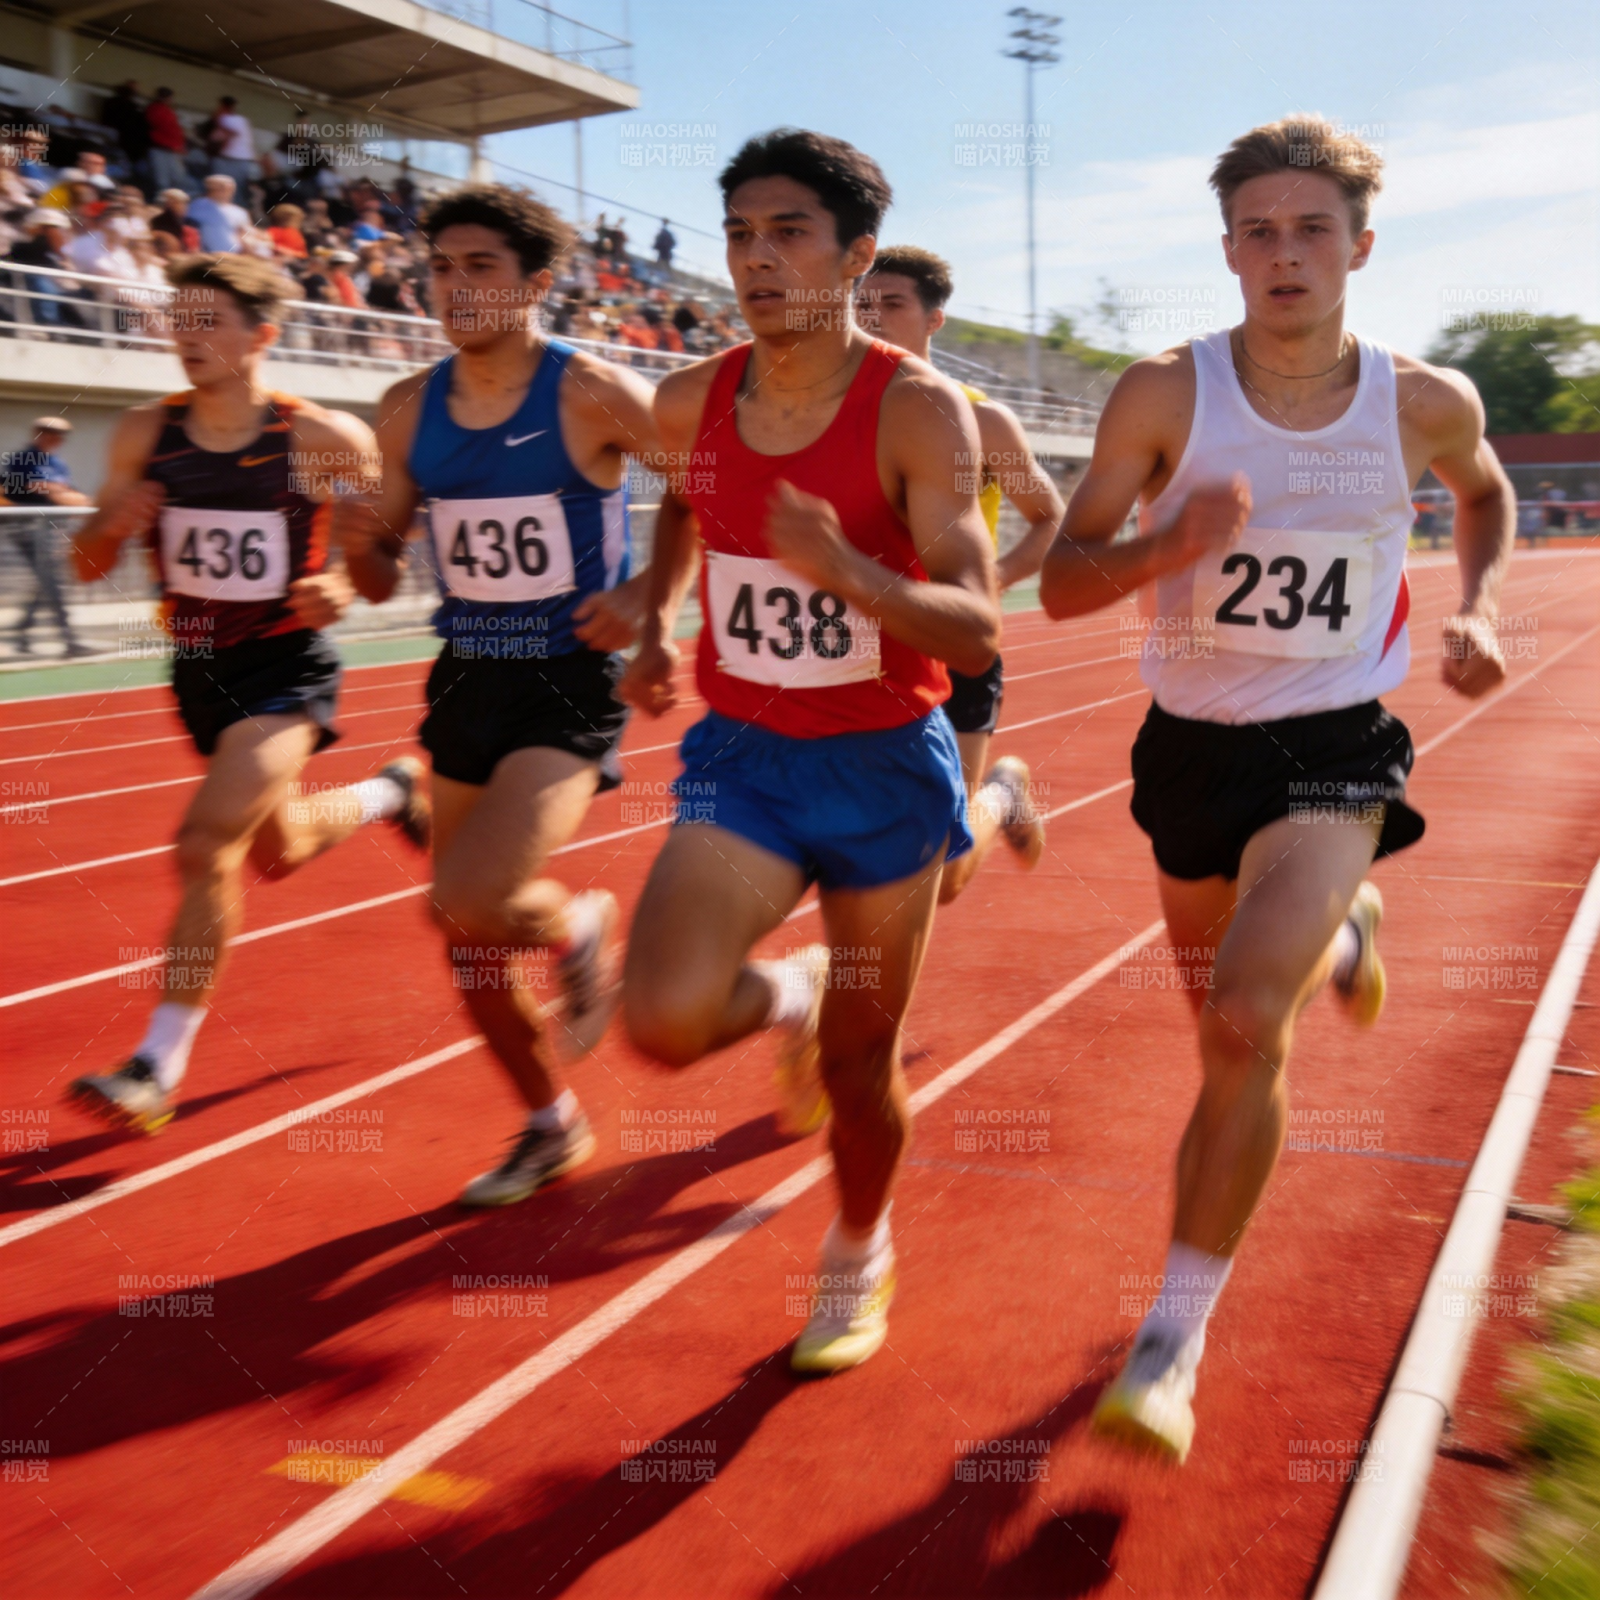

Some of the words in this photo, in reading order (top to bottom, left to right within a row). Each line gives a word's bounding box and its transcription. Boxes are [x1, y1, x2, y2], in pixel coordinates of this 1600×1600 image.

[177, 527, 267, 581] 436
[450, 516, 549, 579] 436
[727, 583, 852, 660] 438
[1215, 553, 1352, 632] 234
